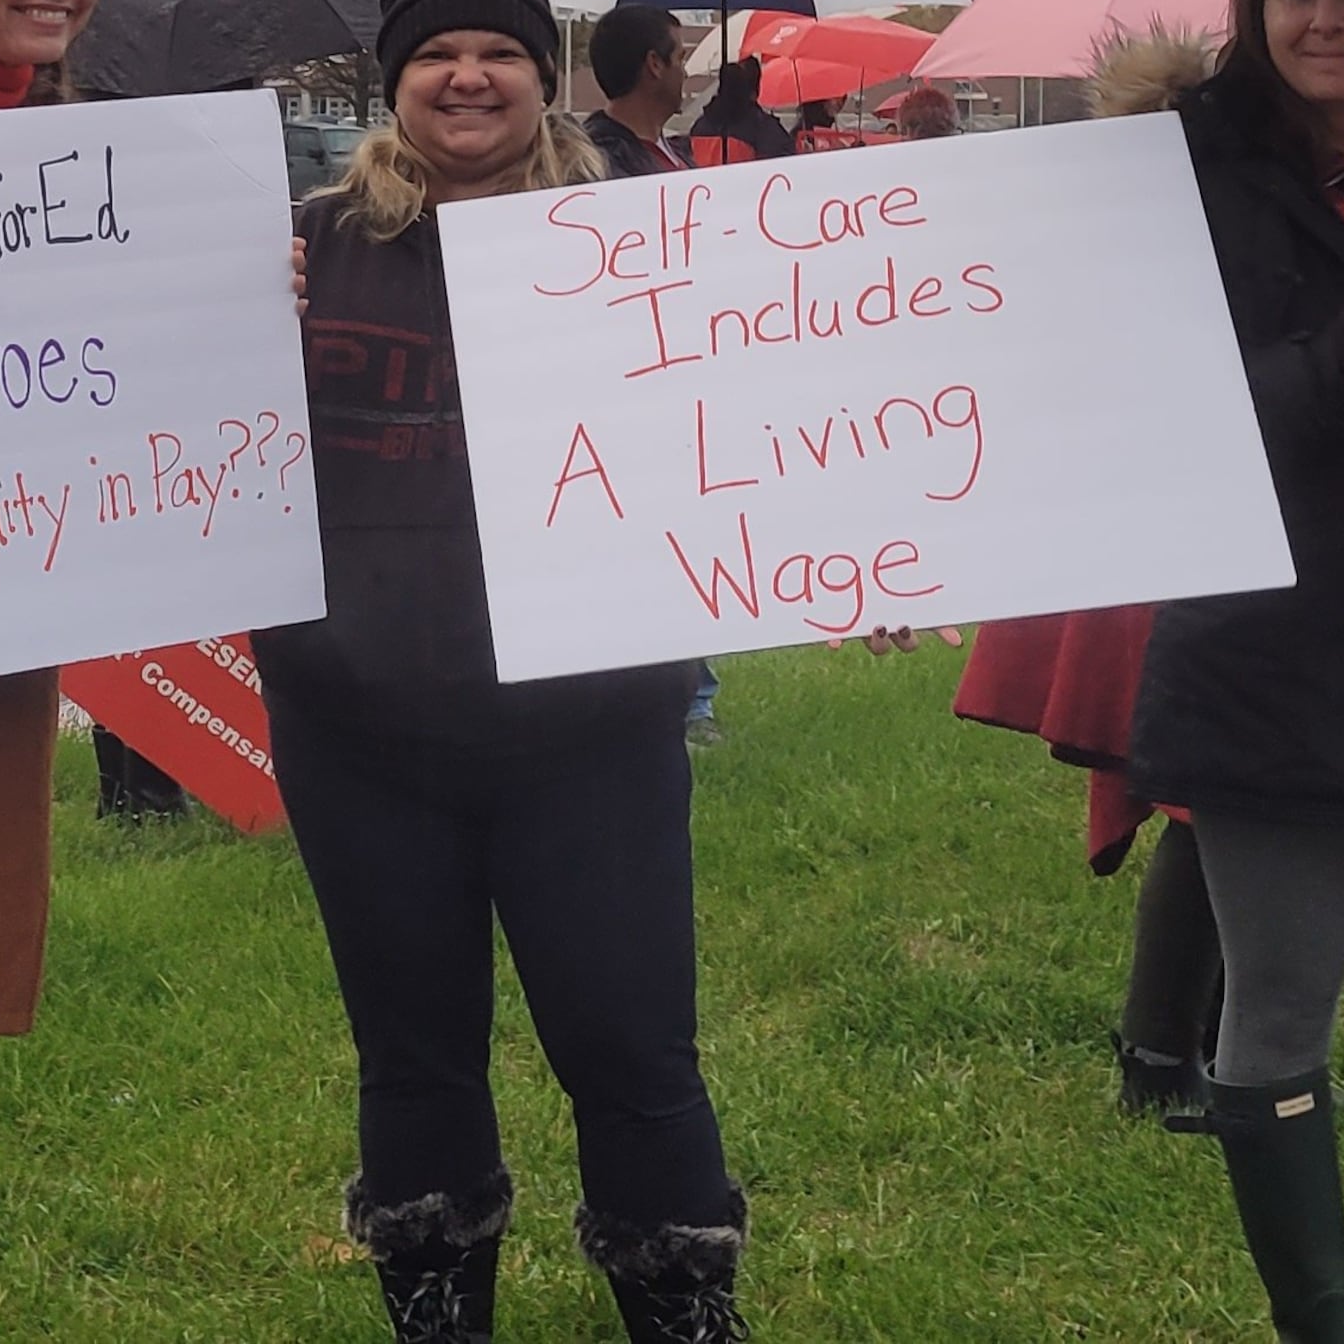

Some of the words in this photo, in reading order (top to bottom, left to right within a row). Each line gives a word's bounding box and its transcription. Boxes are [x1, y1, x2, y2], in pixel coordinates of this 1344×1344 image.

[533, 173, 927, 296] Self-Care
[607, 257, 1004, 379] Includes
[89, 456, 137, 523] in
[546, 422, 624, 528] A
[696, 385, 983, 501] Living
[666, 513, 944, 634] Wage
